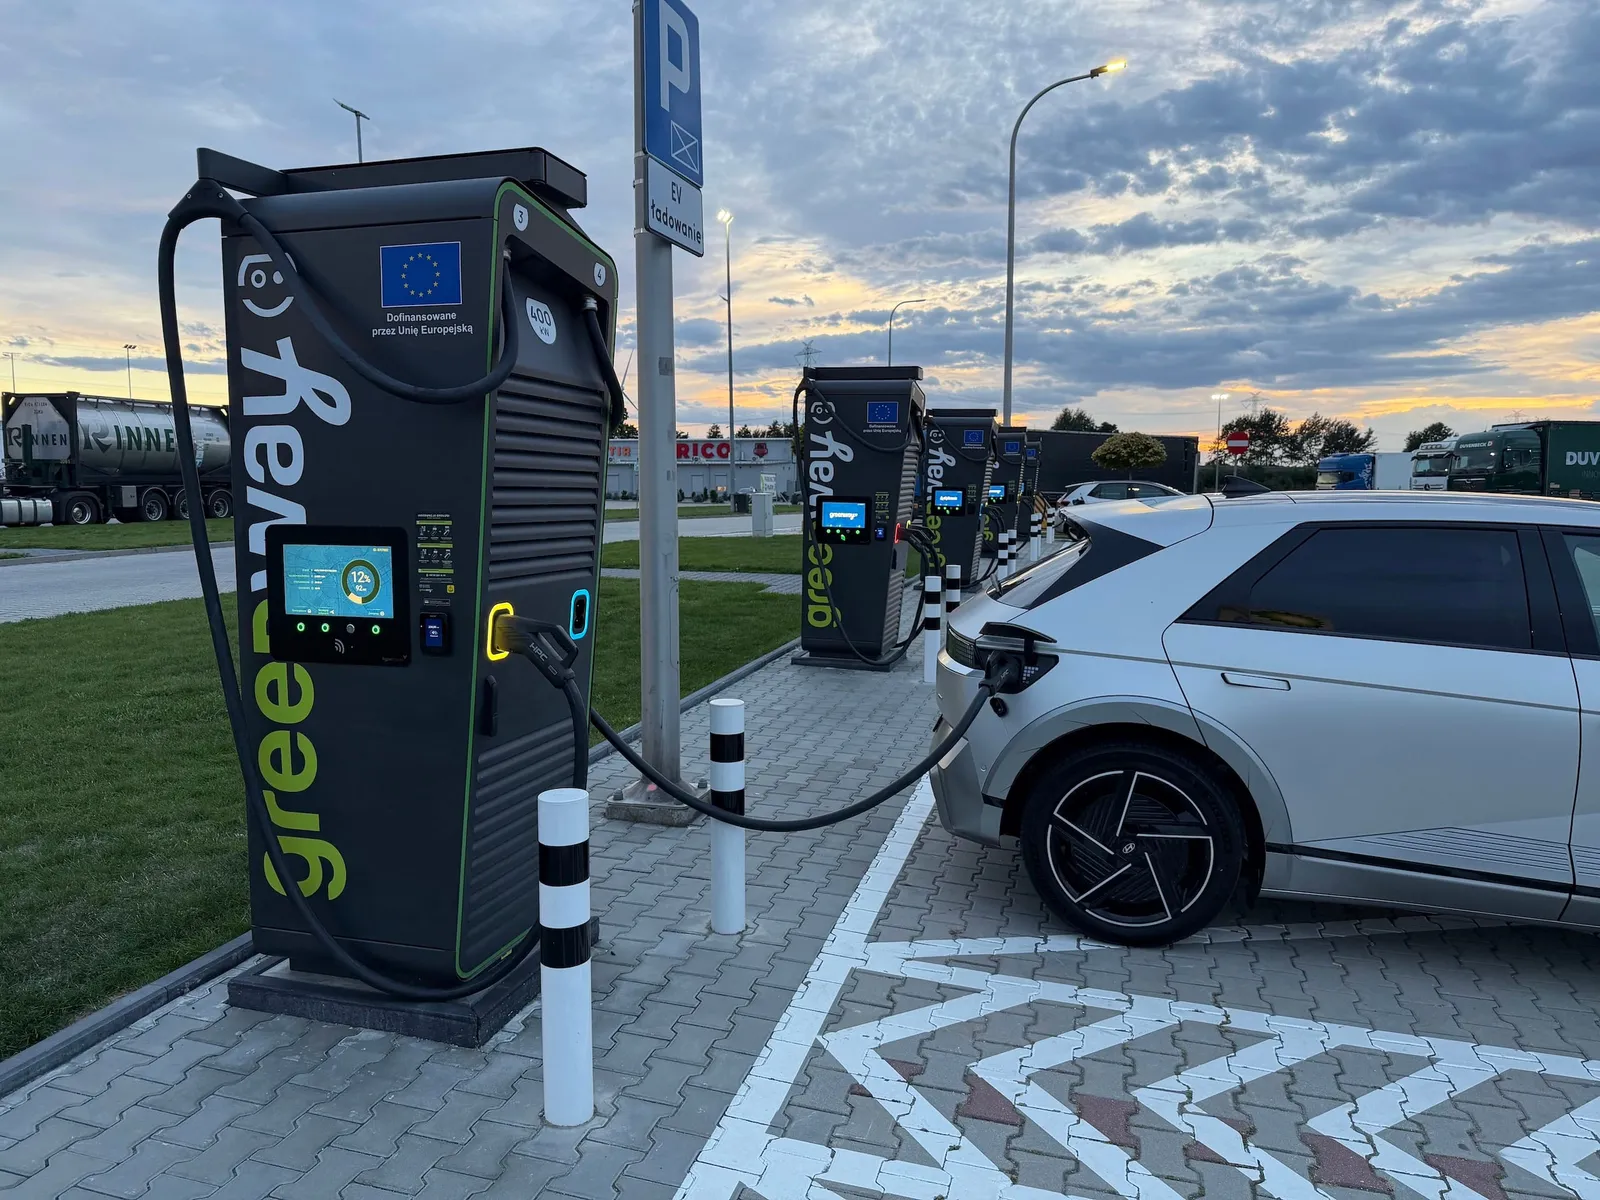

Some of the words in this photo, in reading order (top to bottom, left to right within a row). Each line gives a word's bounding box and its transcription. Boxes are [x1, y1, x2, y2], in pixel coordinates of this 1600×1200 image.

[659, 0, 690, 112] P
[671, 181, 681, 204] EV
[518, 210, 524, 224] 3
[651, 199, 701, 244] ładowanie
[597, 269, 602, 281] 4
[386, 311, 457, 323] Dofinansowane
[530, 305, 552, 327] 400
[372, 326, 397, 337] przez
[398, 325, 419, 337] Unię
[421, 323, 473, 336] Europejską
[6, 427, 67, 447] RNNEN
[807, 431, 854, 627] greeway
[351, 570, 371, 583] 12%
[529, 642, 548, 661] HPC
